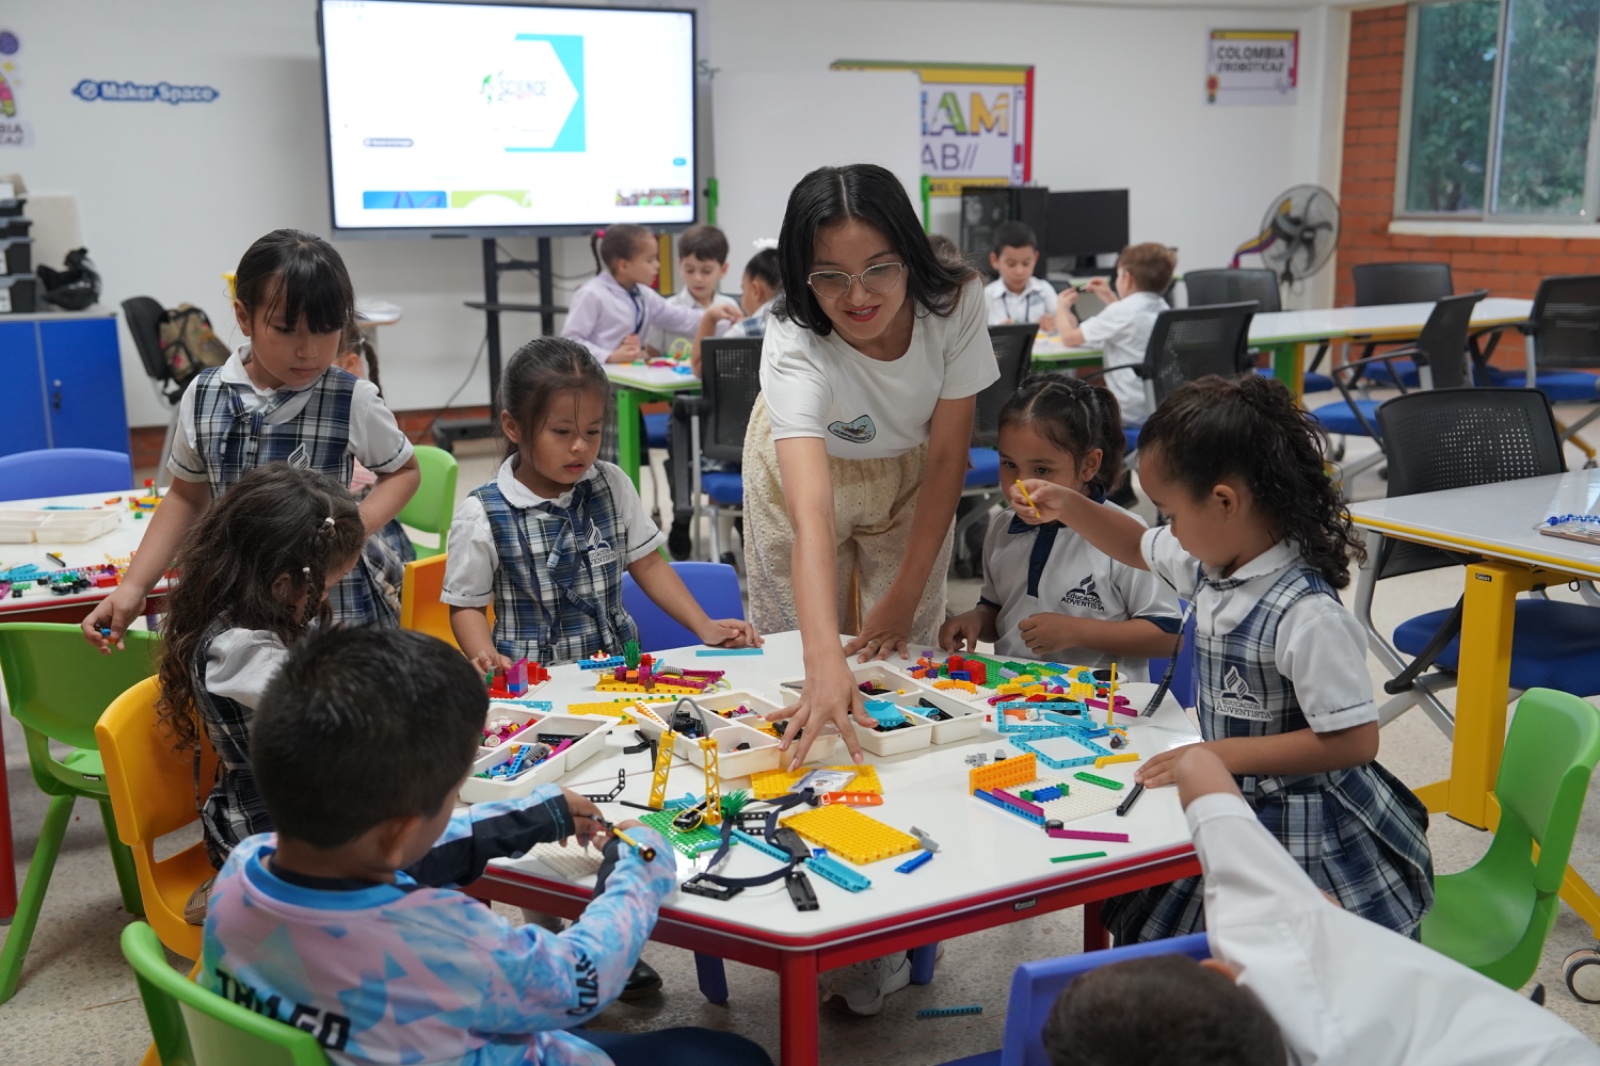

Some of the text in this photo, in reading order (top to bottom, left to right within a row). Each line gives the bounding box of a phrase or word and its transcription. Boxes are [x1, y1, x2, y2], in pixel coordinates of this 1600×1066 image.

[1217, 45, 1285, 59] COLOMBIA
[101, 82, 214, 103] Maker Space
[1061, 596, 1105, 612] ADVENTISTA
[1216, 700, 1272, 719] ADVENTISTA
